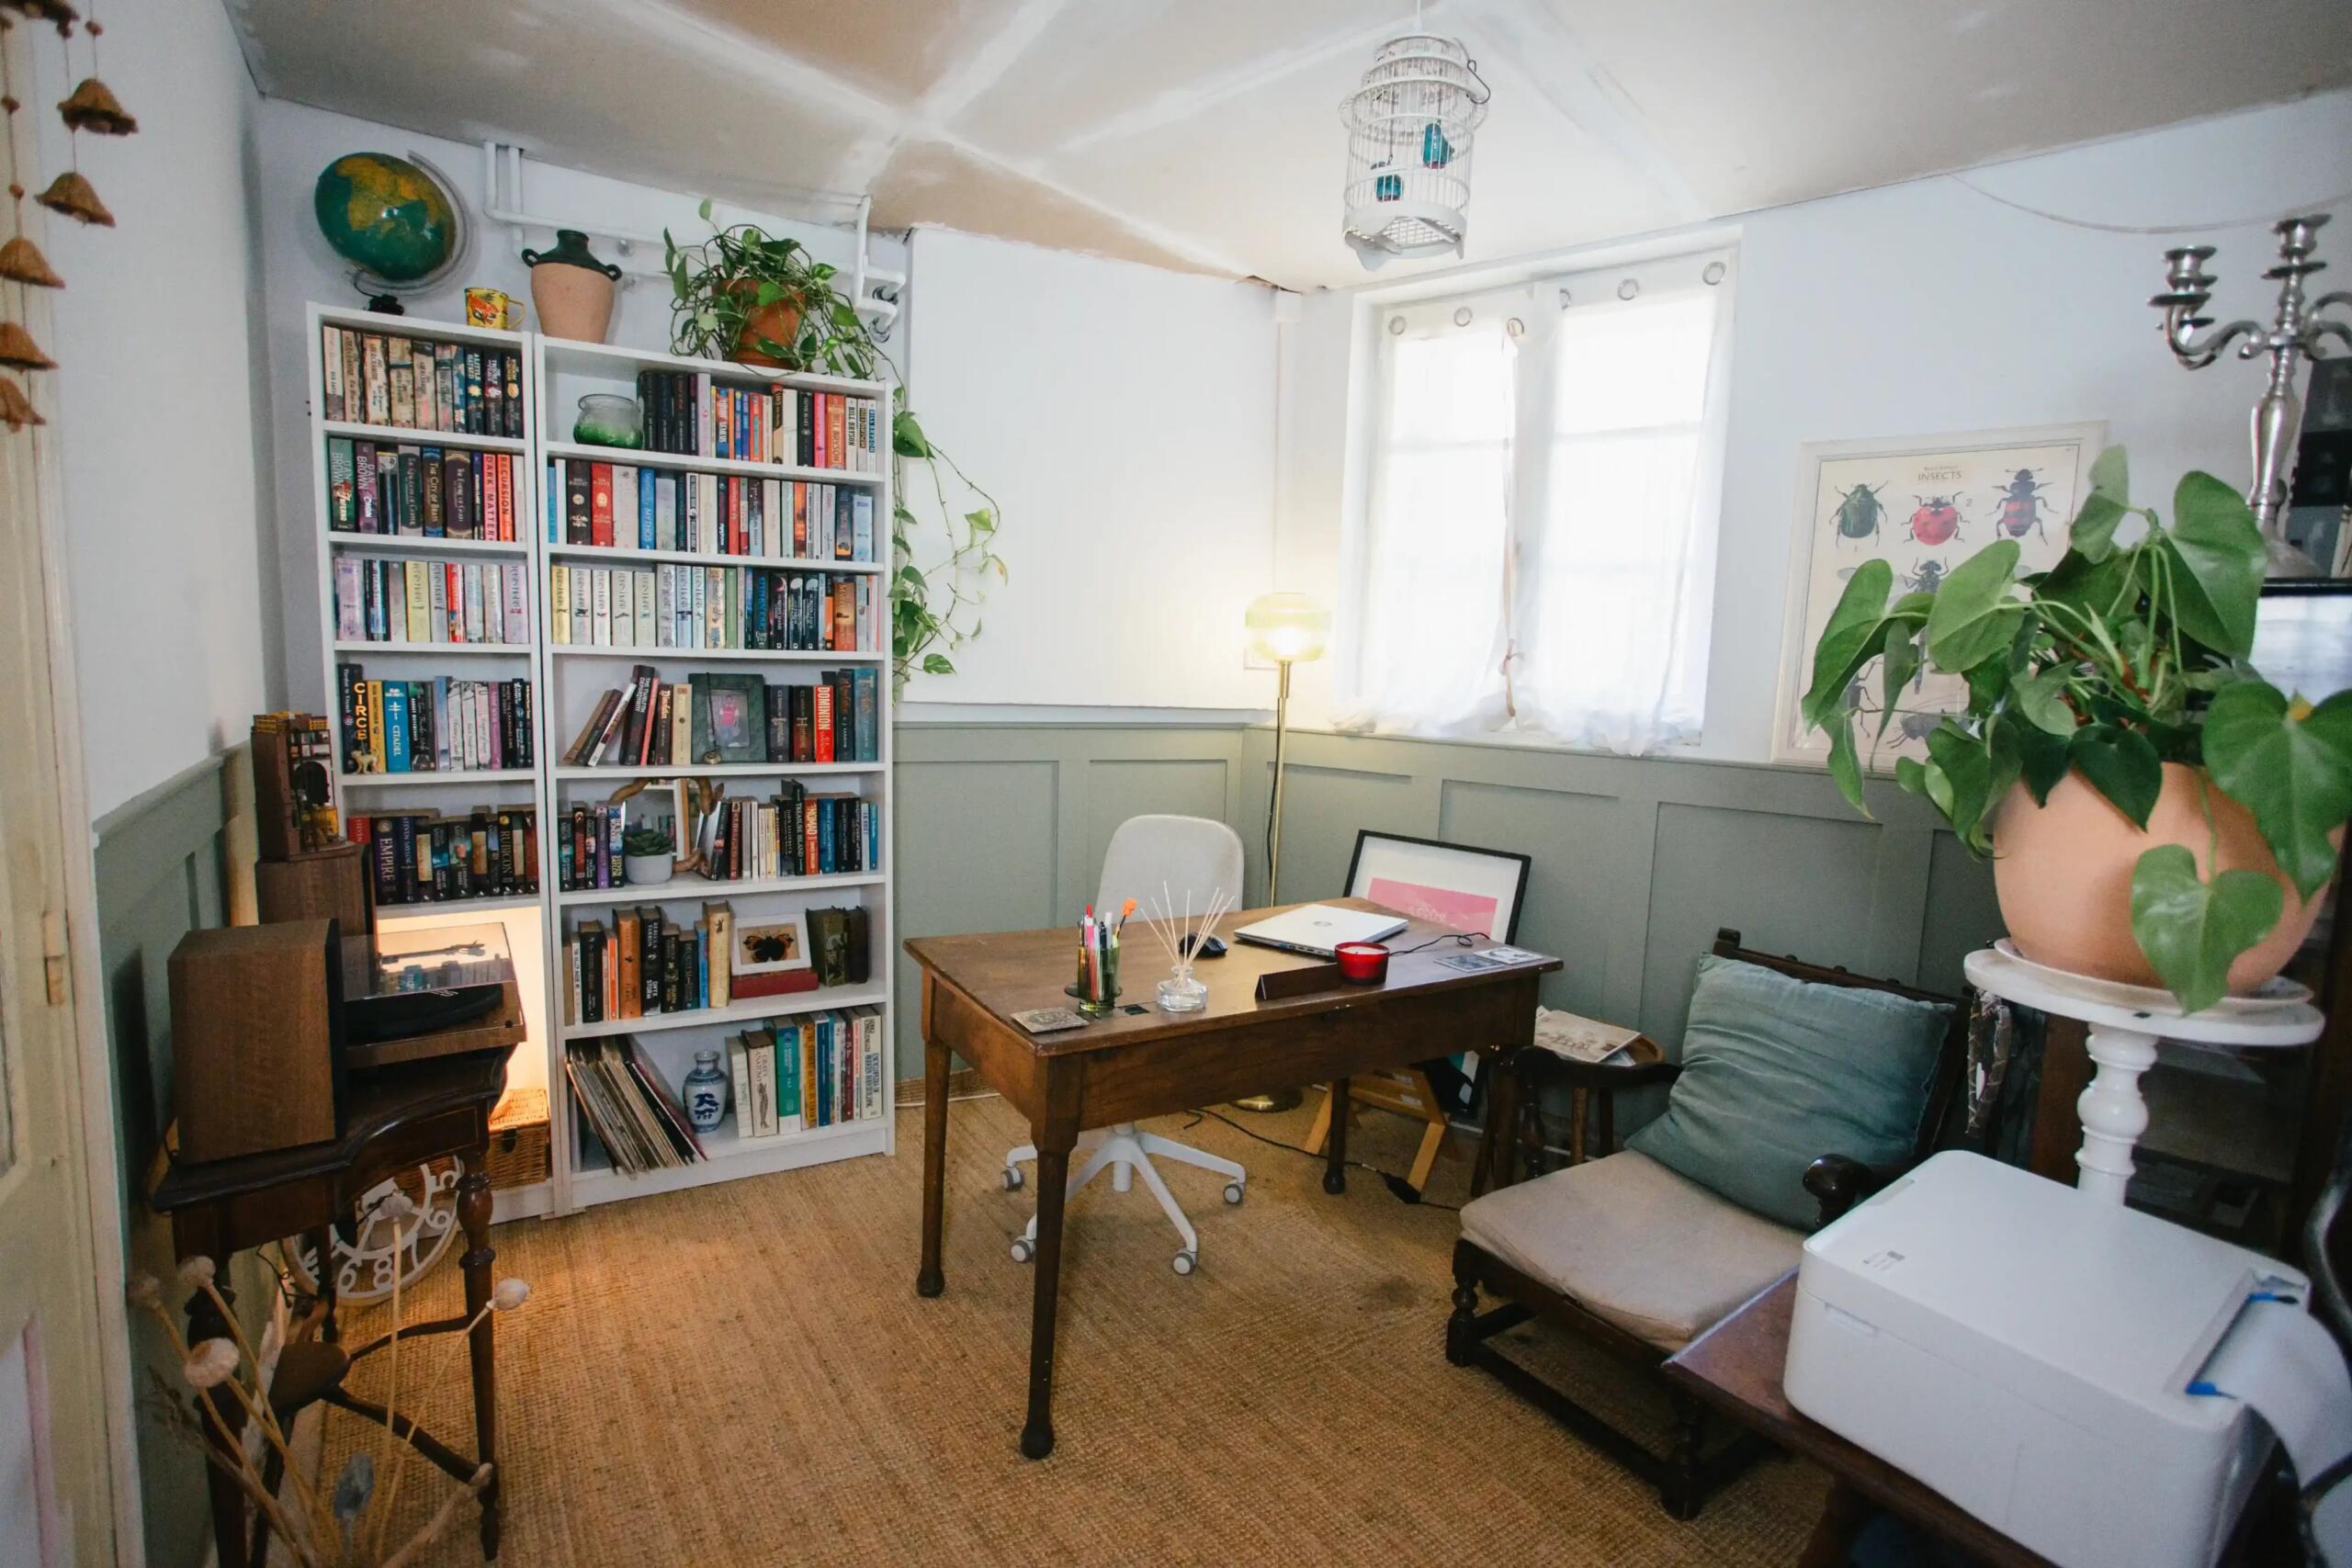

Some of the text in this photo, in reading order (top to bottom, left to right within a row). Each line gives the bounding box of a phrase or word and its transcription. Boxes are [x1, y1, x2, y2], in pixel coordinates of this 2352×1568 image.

[467, 355, 475, 379] HATRED
[832, 413, 841, 462] BILL BRYSON
[332, 453, 344, 486] BROWN
[344, 460, 352, 479] DAN
[356, 456, 368, 490] BROWN
[500, 457, 509, 514] RECURSION
[1918, 470, 1962, 481] INSECTS
[487, 493, 495, 536] MATTER
[354, 682, 368, 740] CIRCE
[635, 677, 645, 712] DEPARTMENT
[640, 688, 650, 713] TWELFTH
[659, 690, 671, 719] Dissolution
[818, 687, 831, 730] DOMINION
[392, 725, 401, 757] CITADEL
[807, 808, 817, 835] NOMAD
[379, 838, 395, 882] EMPIRE
[501, 830, 513, 874] RUBICON
